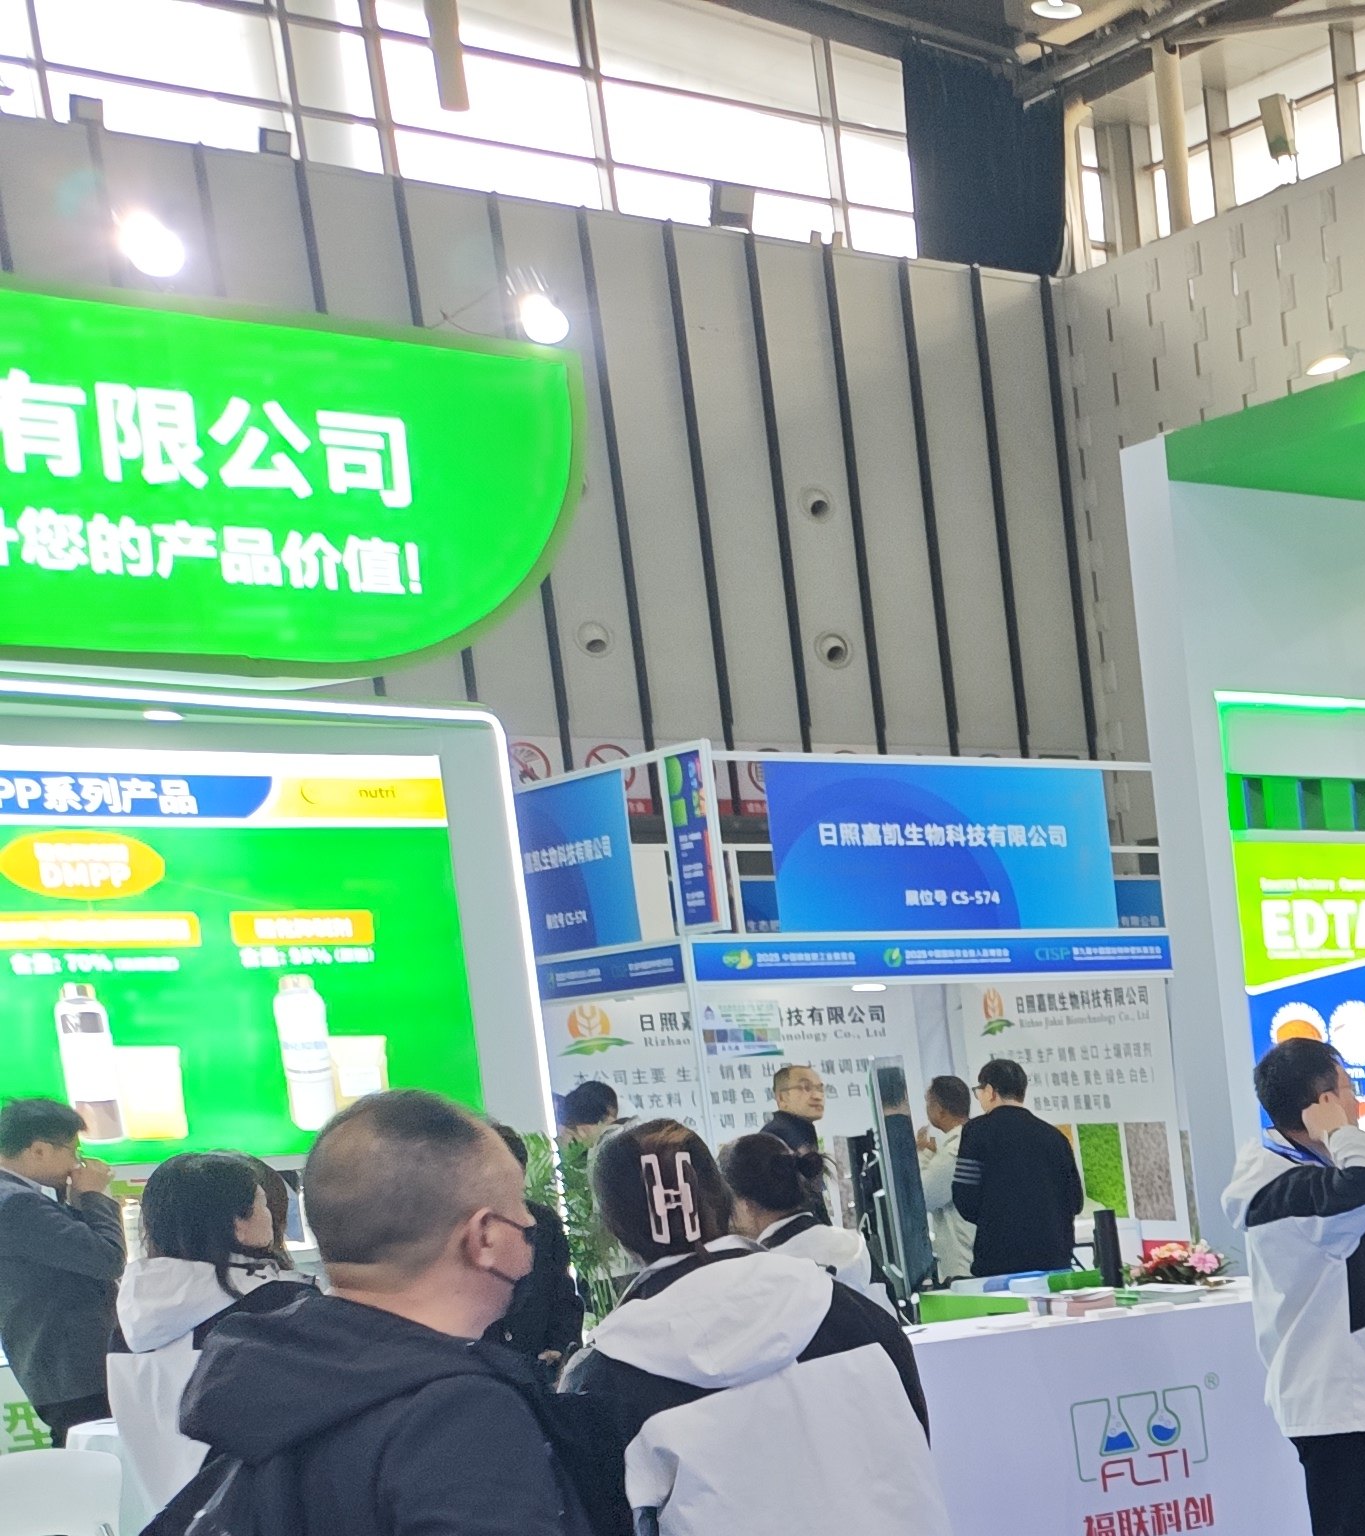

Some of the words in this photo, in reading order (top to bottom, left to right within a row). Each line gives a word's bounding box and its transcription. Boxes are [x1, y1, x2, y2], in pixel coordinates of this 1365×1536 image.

[0, 369, 413, 508] 有限公司
[818, 822, 1068, 848] 日照嘉凯生物科技有限公司
[905, 889, 947, 906] 展位号
[952, 889, 1000, 906] CS-574
[778, 1004, 886, 1028] 技有限公司
